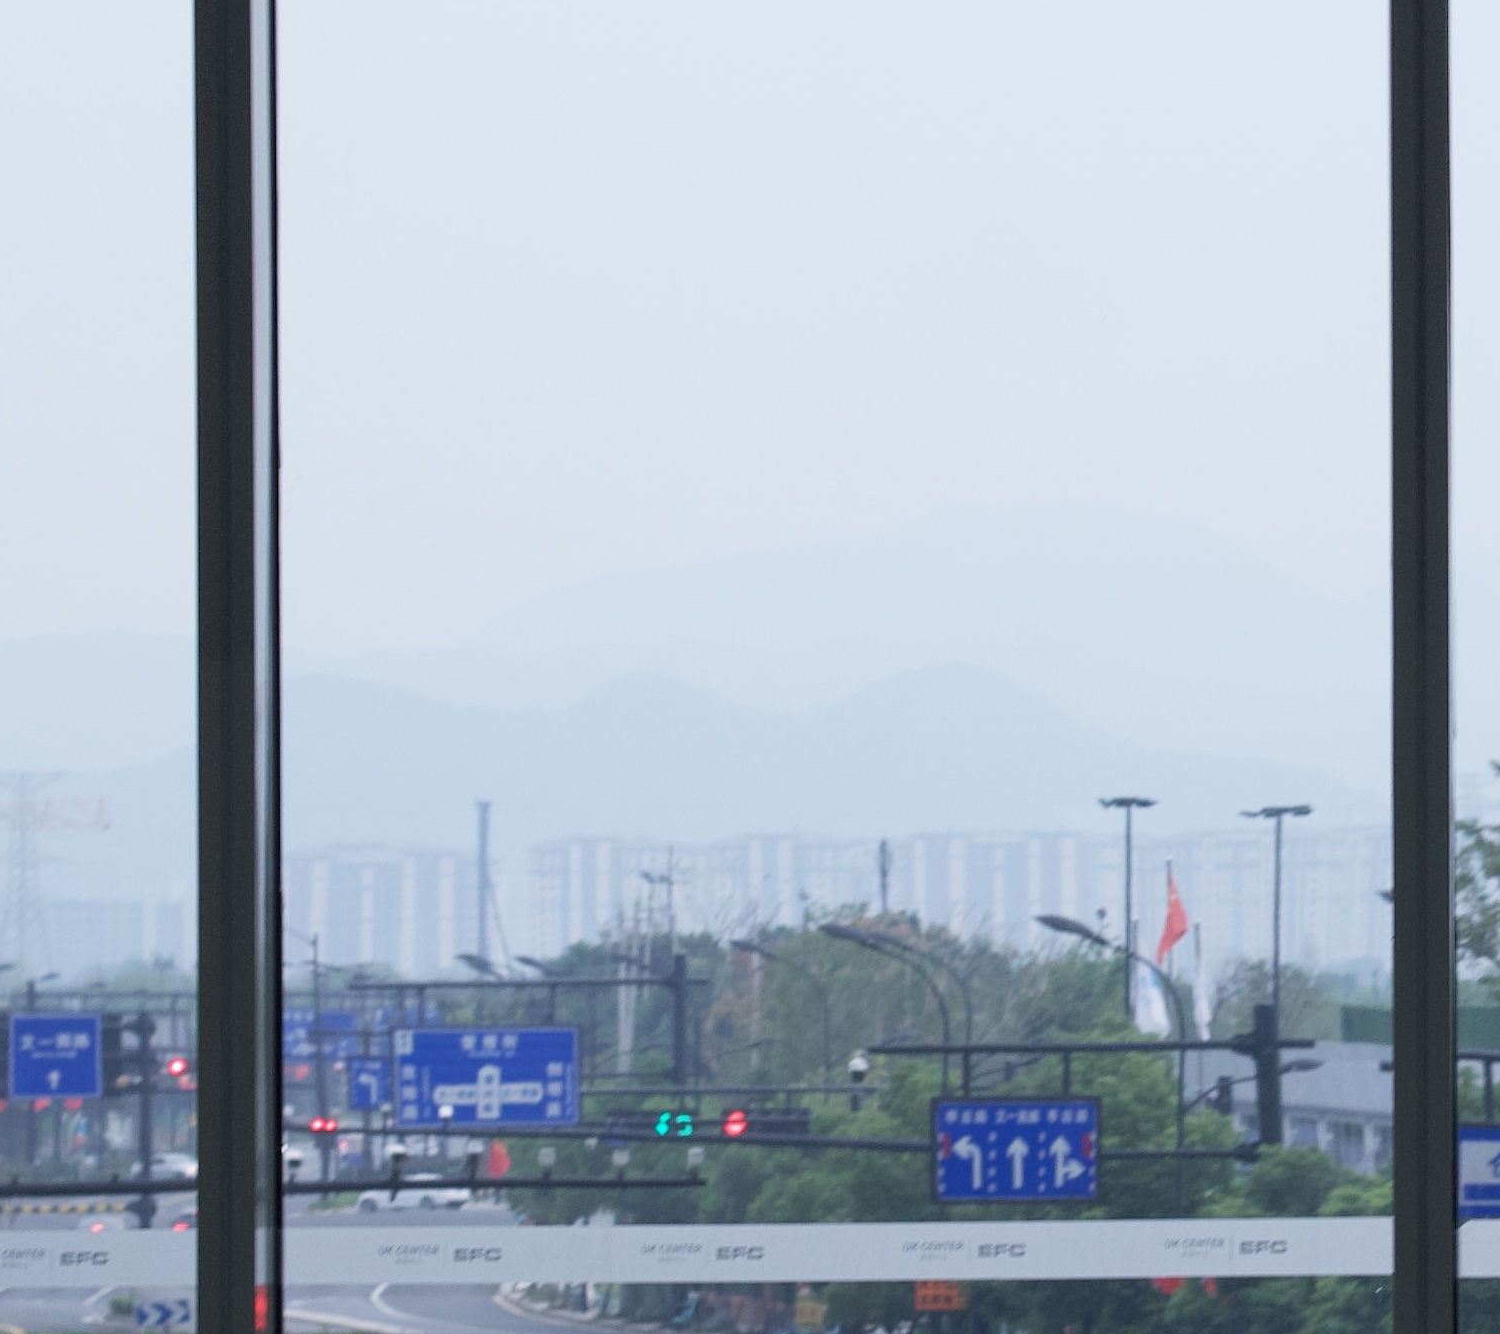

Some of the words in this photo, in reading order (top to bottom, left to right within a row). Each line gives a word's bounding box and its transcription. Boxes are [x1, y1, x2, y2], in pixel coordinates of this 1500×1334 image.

[453, 1247, 502, 1262] EFC
[715, 1246, 765, 1261] EFC
[977, 1243, 1026, 1258] EFC
[1239, 1239, 1288, 1255] EFC
[59, 1251, 109, 1266] EFC
